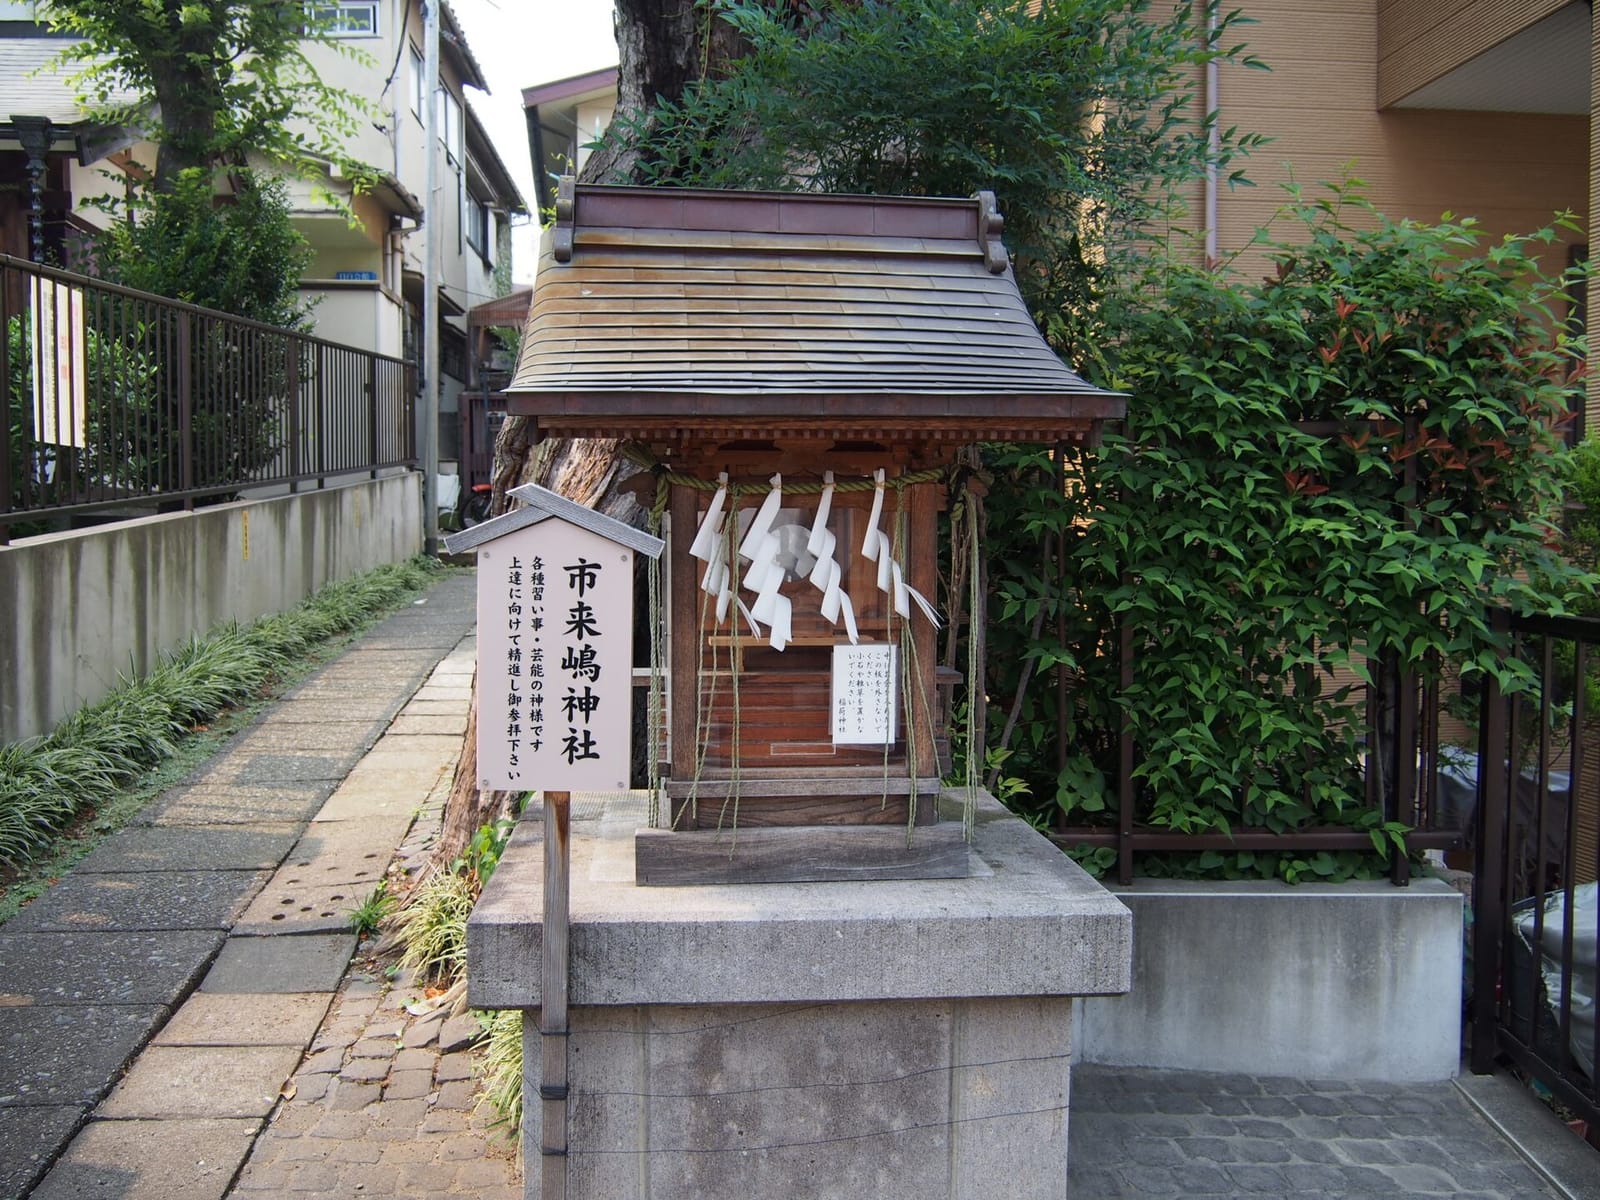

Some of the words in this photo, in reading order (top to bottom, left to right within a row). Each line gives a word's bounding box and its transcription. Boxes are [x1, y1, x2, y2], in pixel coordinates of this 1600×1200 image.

[507, 555, 522, 780] 上達に向けて精進し御参拝下さい
[529, 555, 545, 753] 各種習い事・芸能の神様です
[561, 558, 602, 765] 市来嶋神社
